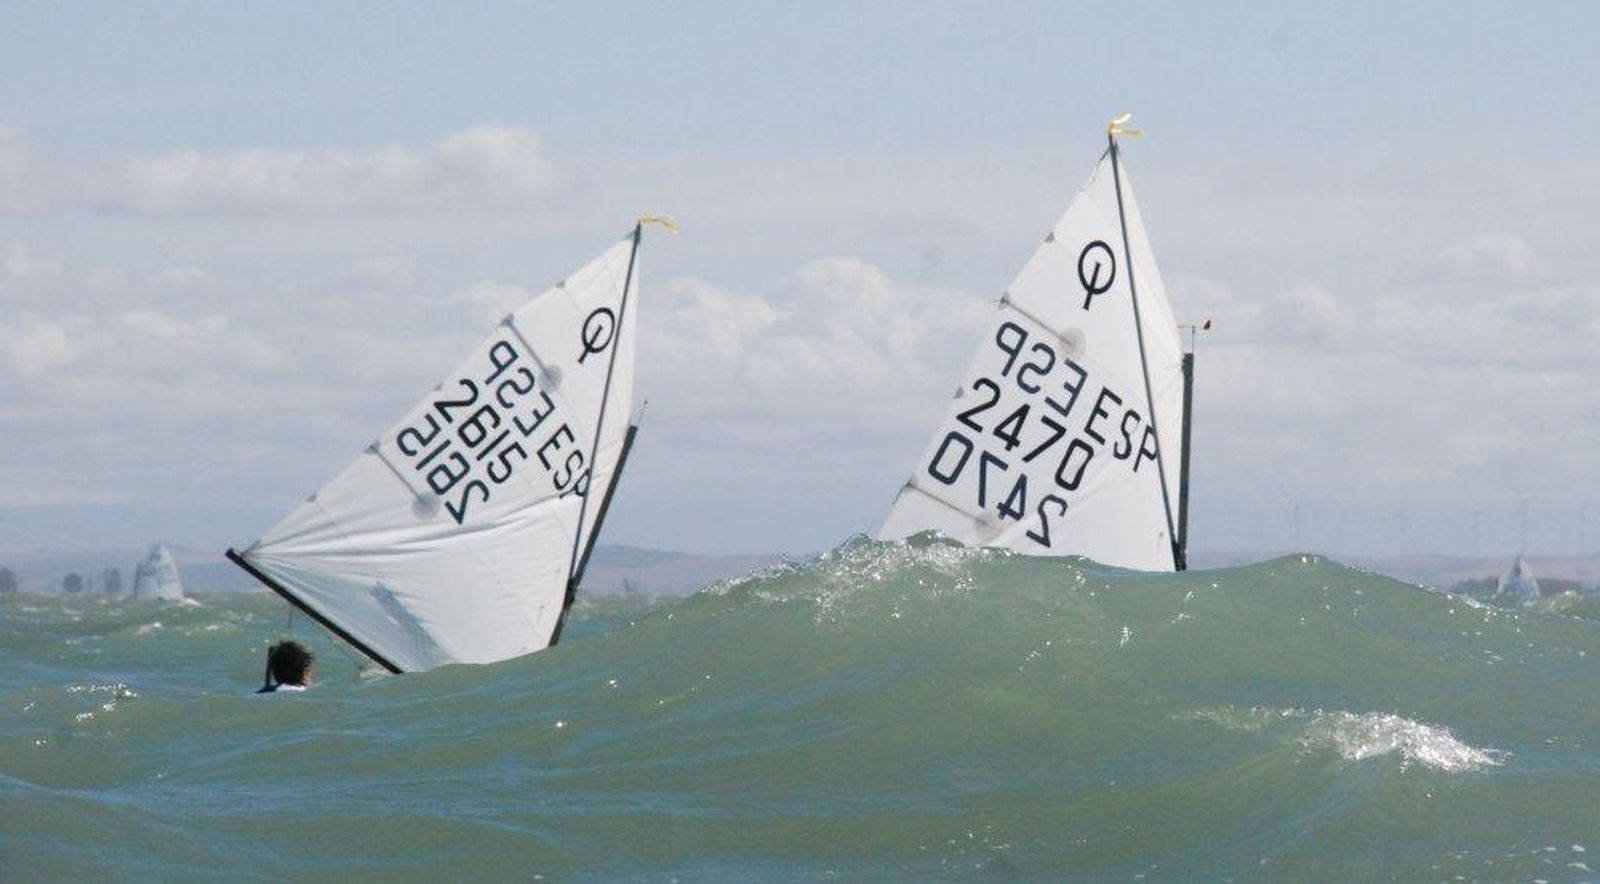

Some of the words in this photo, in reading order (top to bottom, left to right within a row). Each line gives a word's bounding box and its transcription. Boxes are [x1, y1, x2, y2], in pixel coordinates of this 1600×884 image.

[433, 379, 528, 484] 2615
[536, 423, 592, 500] ESP
[956, 377, 1095, 492] 2470
[1083, 386, 1160, 473] ESP
